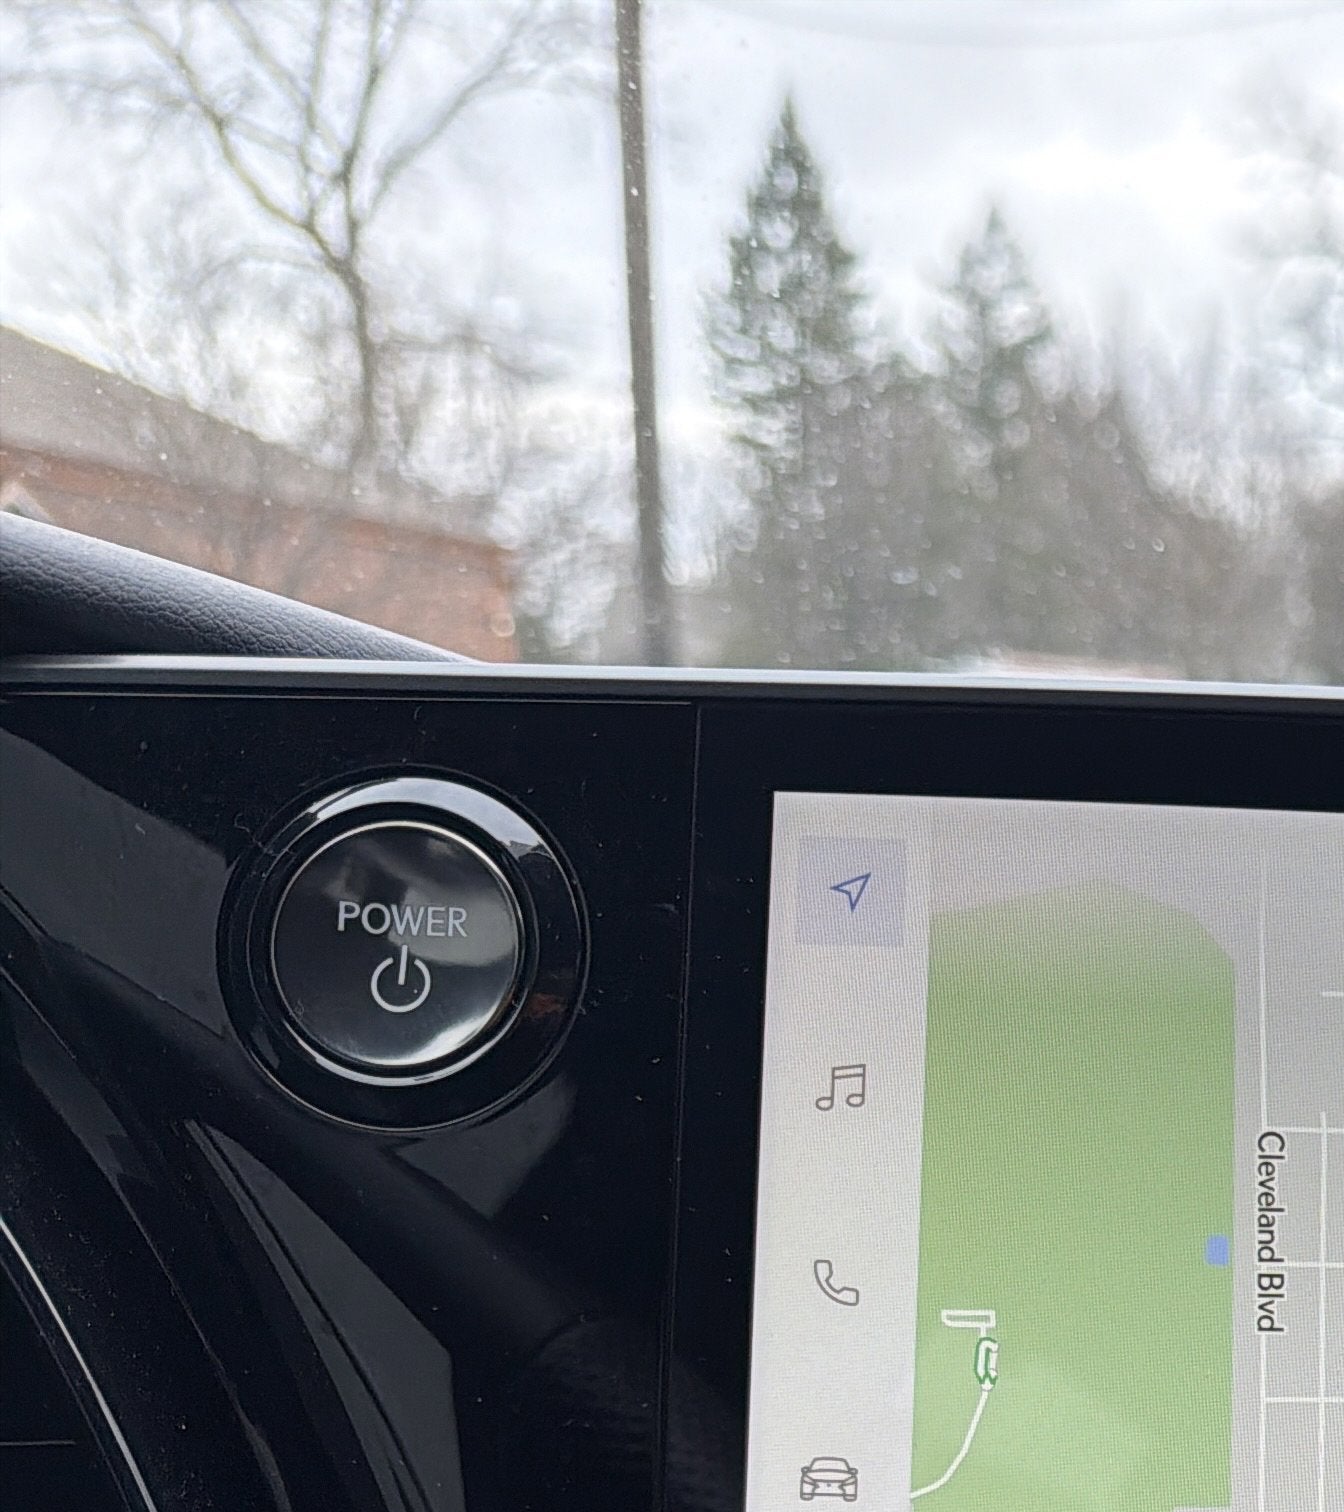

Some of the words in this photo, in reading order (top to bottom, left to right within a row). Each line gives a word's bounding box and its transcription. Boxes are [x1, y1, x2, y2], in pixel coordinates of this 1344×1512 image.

[336, 900, 467, 938] POWER
[1257, 1131, 1285, 1263] Cleveland
[1257, 1273, 1285, 1332] Blvd
